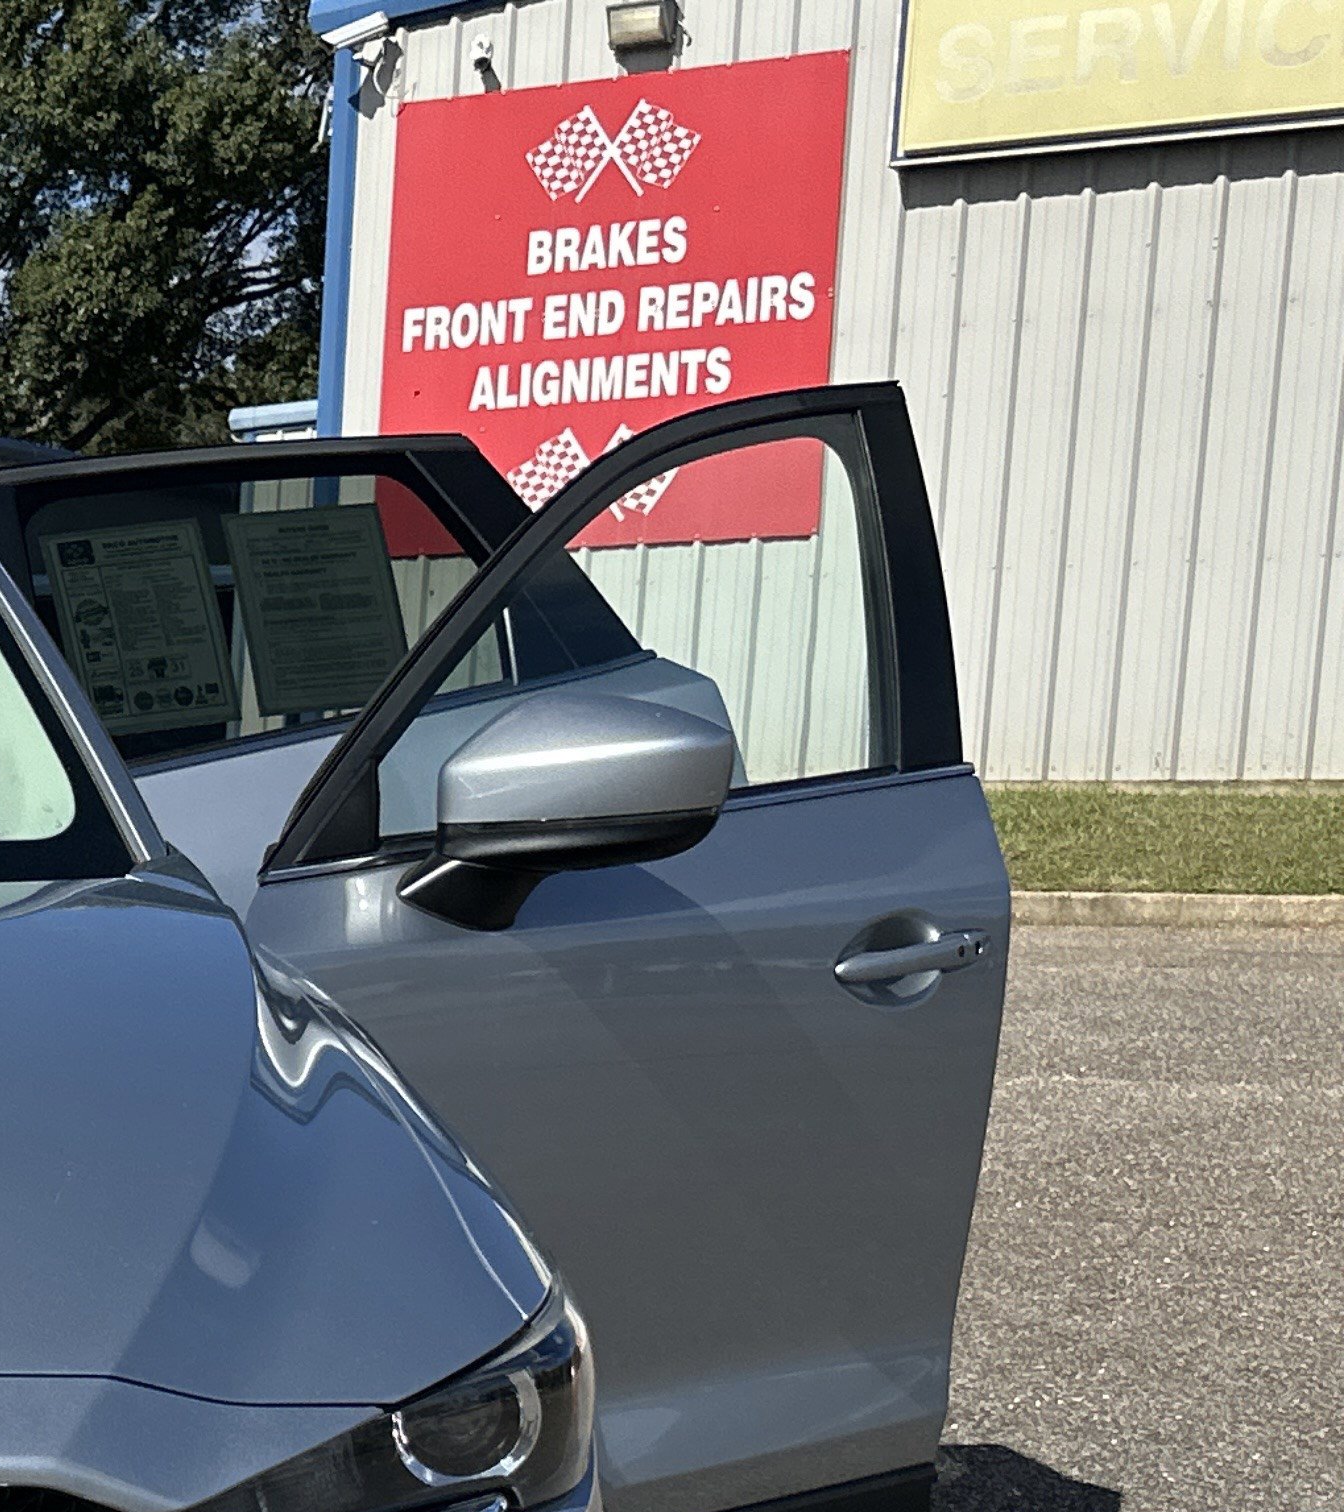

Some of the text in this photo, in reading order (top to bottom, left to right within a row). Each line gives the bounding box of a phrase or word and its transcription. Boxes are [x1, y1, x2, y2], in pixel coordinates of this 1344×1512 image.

[934, 0, 1344, 104] SERVIC
[526, 216, 689, 277] BRAKES
[402, 271, 816, 353] FRONT END REPAIRS
[468, 346, 732, 412] ALIGNMENTS
